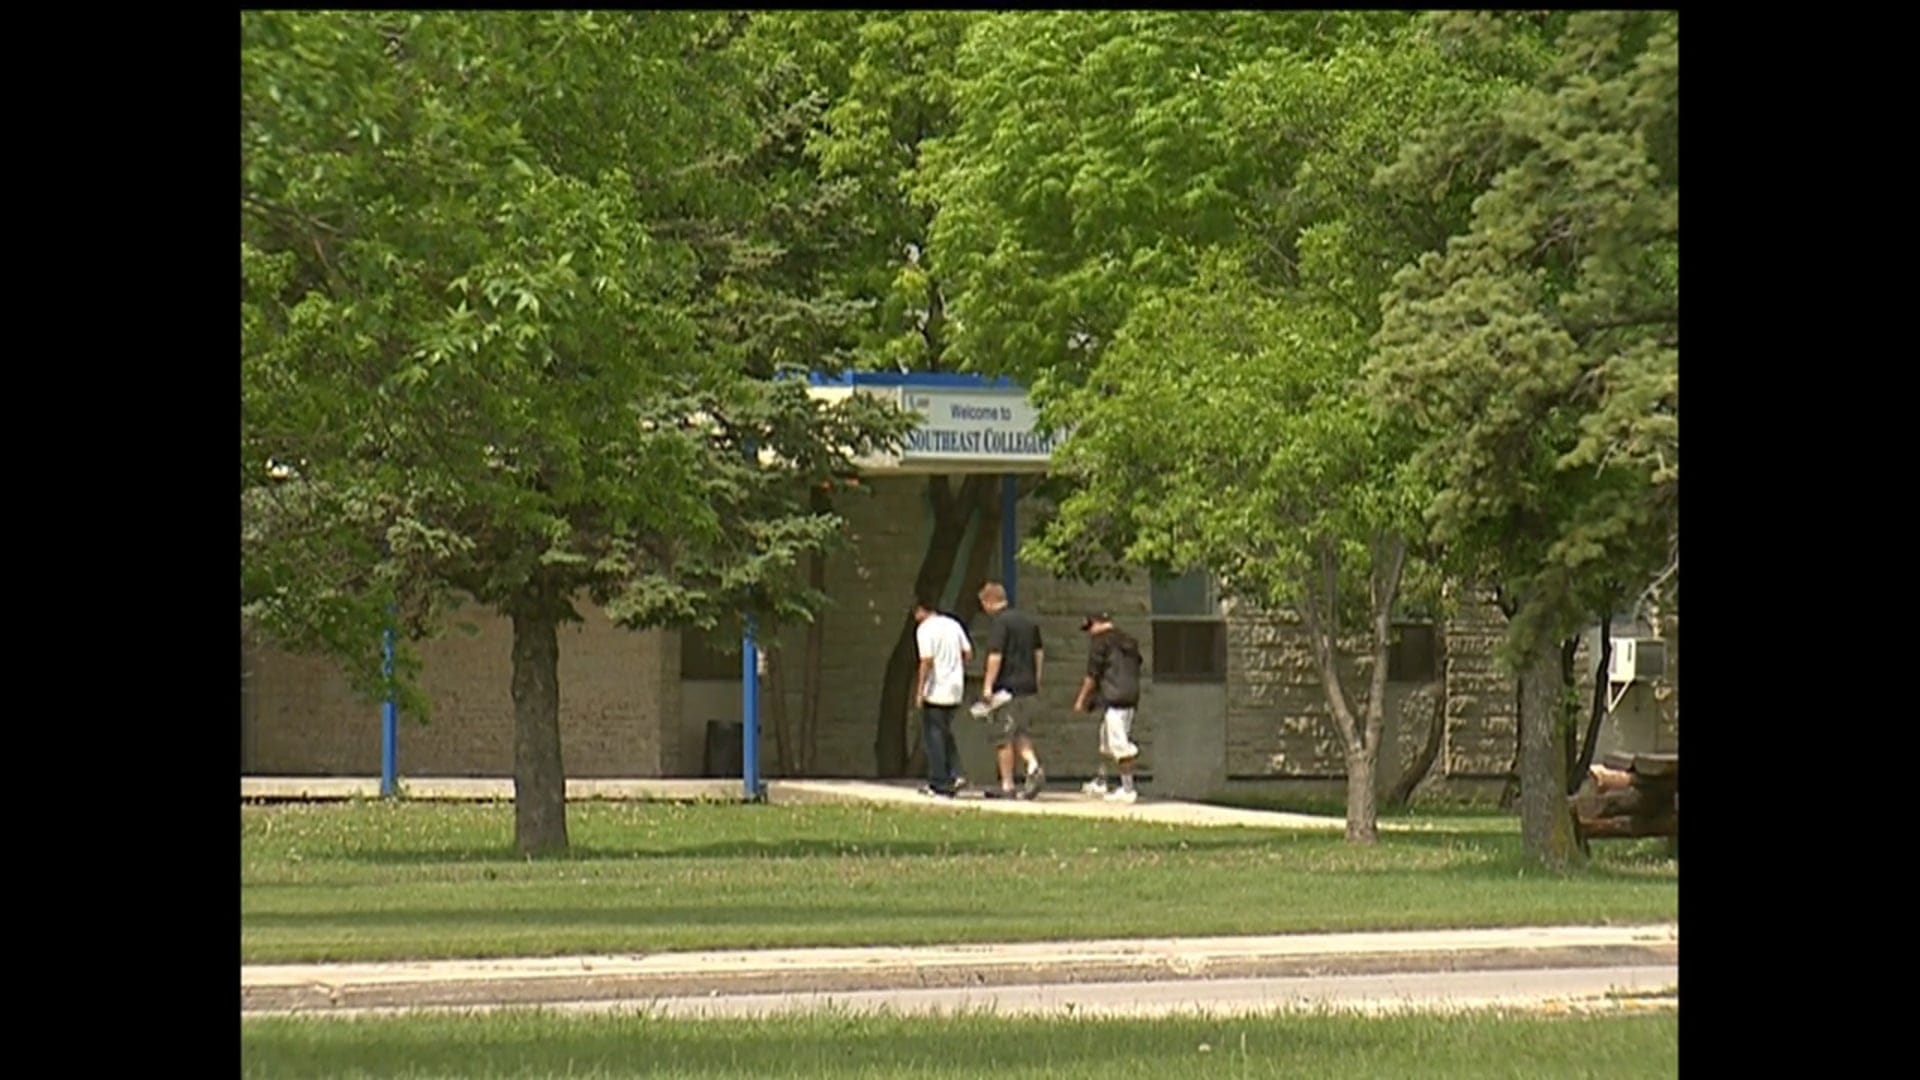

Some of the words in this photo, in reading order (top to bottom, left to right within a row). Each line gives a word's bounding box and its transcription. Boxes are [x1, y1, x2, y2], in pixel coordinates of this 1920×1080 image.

[951, 404, 998, 421] Welcome
[1001, 406, 1012, 421] to
[906, 428, 981, 453] SOUTHEAST
